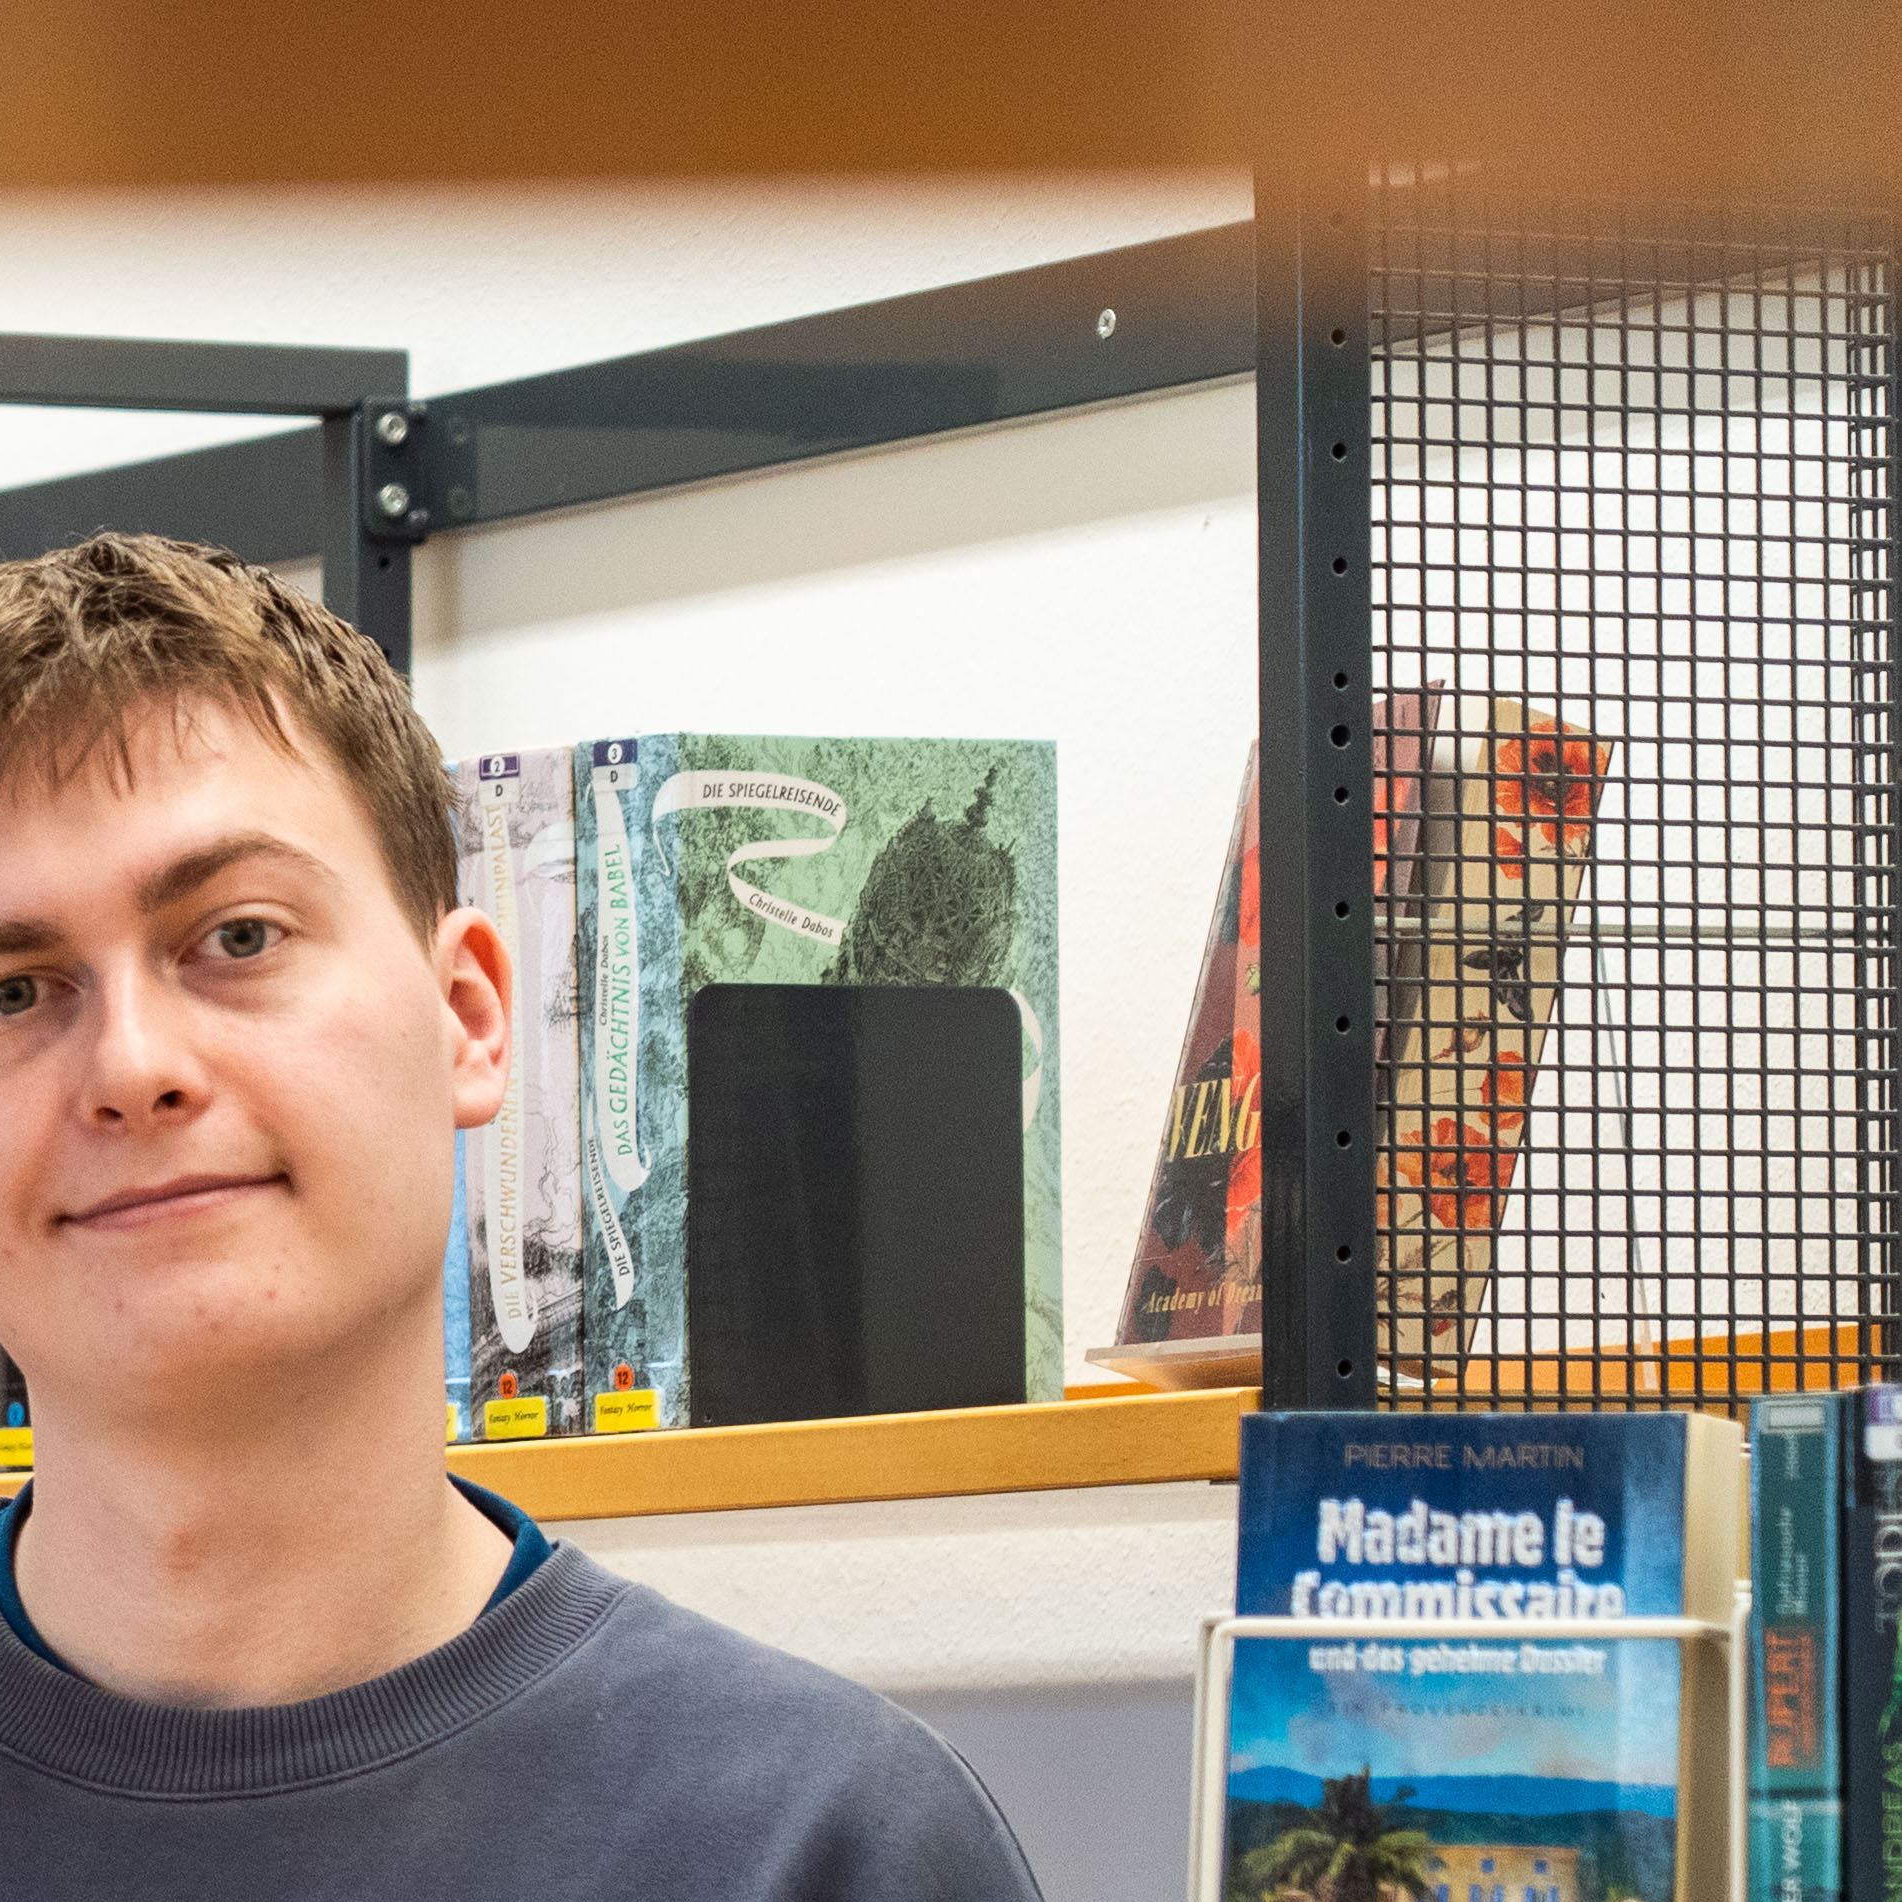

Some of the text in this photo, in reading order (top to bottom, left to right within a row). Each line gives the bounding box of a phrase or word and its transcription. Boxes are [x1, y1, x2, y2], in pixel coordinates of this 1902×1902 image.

[493, 760, 502, 773] 2
[611, 747, 619, 760] 3
[495, 784, 504, 797] D
[609, 770, 619, 783] D
[703, 783, 841, 817] DIE SPIEGELREISENDE
[750, 893, 834, 938] Christelle Dabos
[599, 935, 610, 1026] Christelle Dabos
[606, 844, 633, 1157] DAS GEDÄCHTNIS VON BABEL
[1168, 1073, 1262, 1163] VENG
[589, 1138, 630, 1277] DIE SPIEGELREISENDE
[507, 1291, 523, 1321] DIE
[1149, 1287, 1205, 1314] Academy
[1208, 1282, 1224, 1307] of
[500, 1378, 513, 1394] 12
[617, 1369, 629, 1386] 12
[1345, 1444, 1585, 1469] PIERRE MARTIN
[1318, 1496, 1606, 1567] Madame le
[1291, 1568, 1626, 1620] Commissaire
[1308, 1642, 1607, 1677] und das geheime Dossier
